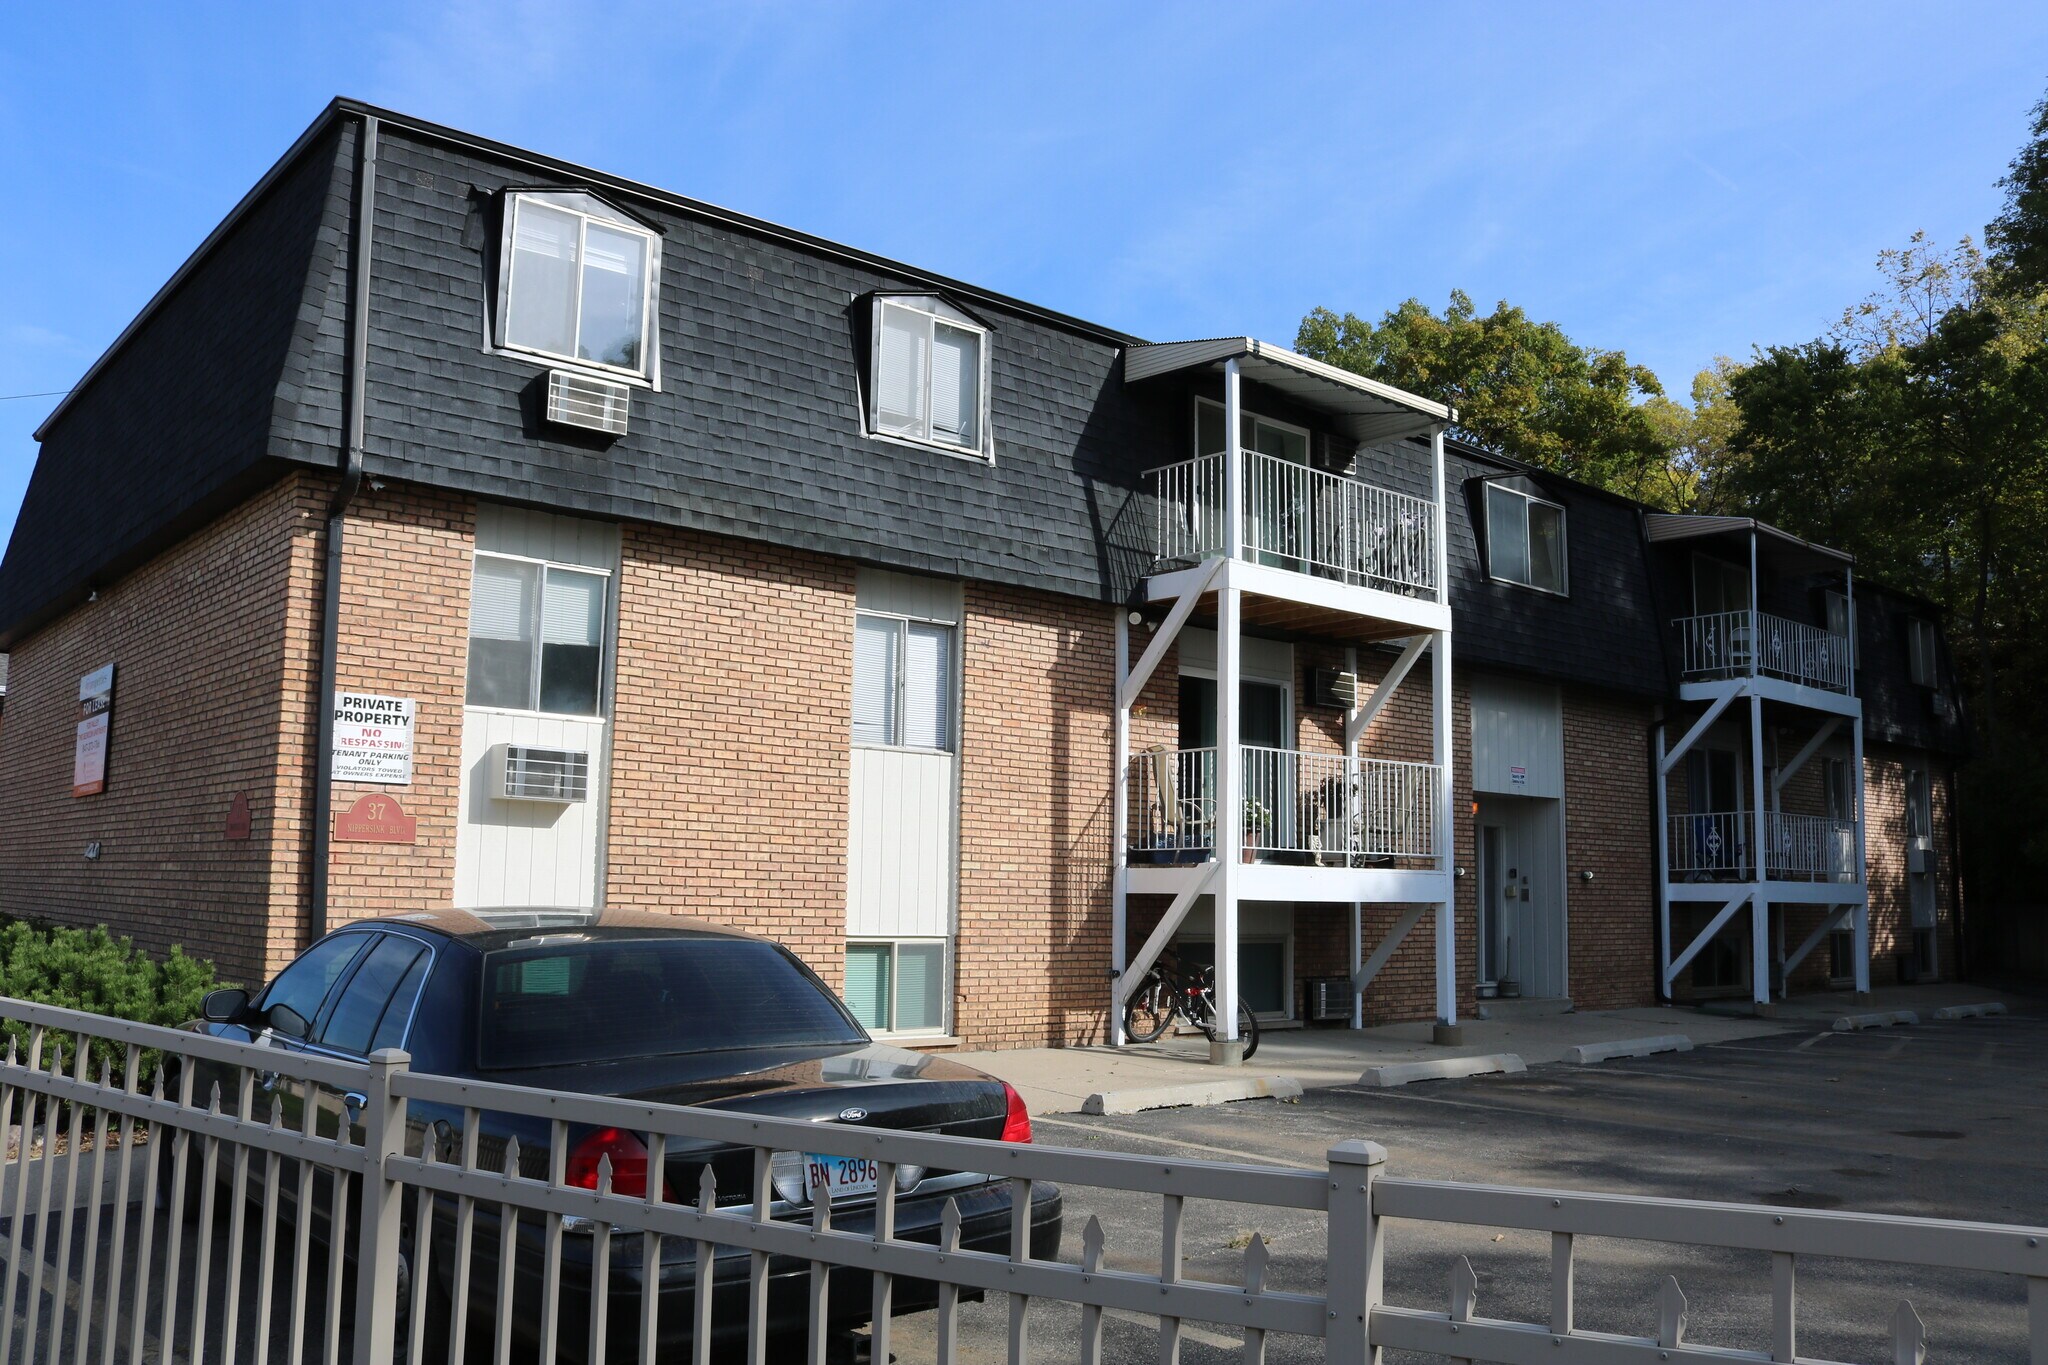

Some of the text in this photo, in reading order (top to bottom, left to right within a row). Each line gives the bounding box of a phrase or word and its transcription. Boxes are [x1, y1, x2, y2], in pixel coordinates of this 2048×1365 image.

[343, 696, 403, 712] PRIVATE
[334, 709, 410, 726] PROPERTY
[361, 728, 382, 738] NO
[340, 737, 406, 749] RESPASSIN
[332, 749, 409, 761] TENANT PARKING
[358, 758, 382, 766] ONLY
[367, 803, 386, 820] 37
[347, 823, 385, 834] NIPPERSINK
[846, 1109, 862, 1119] Ford
[809, 1158, 877, 1189] BN 2896
